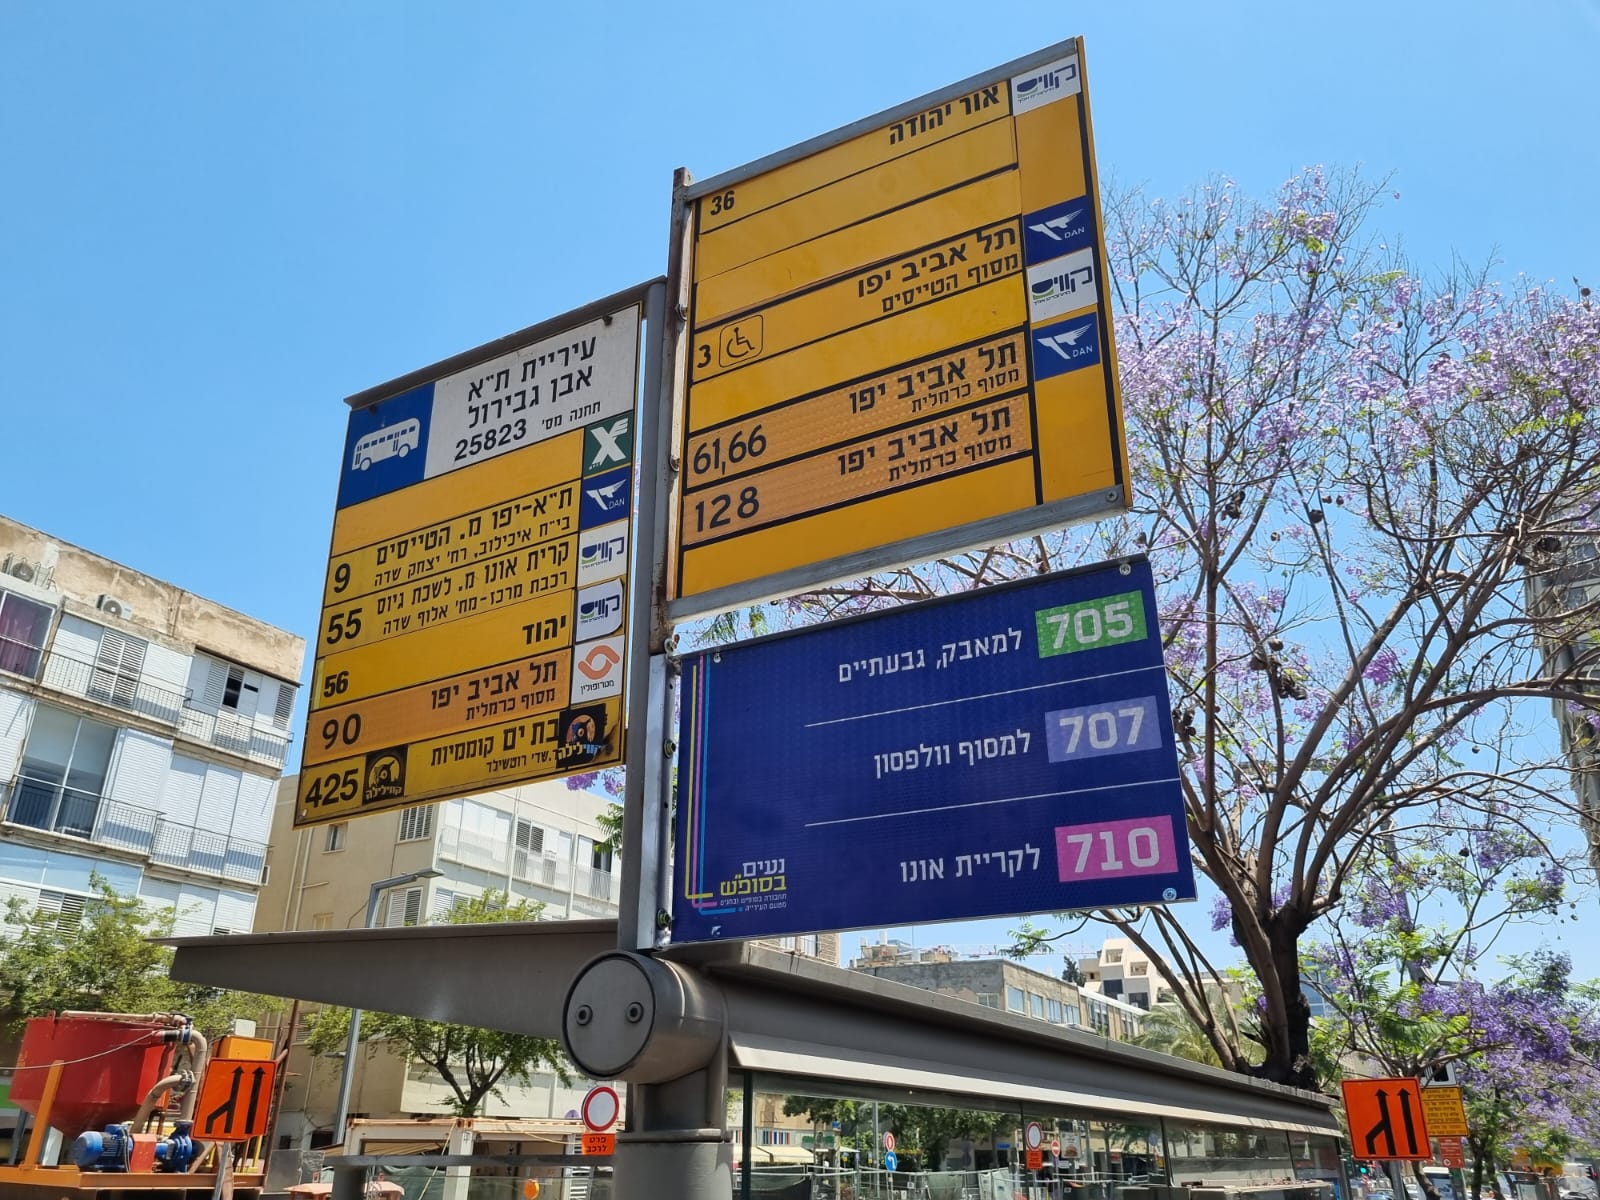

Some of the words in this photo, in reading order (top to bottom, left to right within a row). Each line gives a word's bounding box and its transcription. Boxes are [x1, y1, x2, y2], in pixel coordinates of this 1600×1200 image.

[959, 85, 1000, 115] אור
[889, 104, 951, 145] יהודה
[710, 190, 735, 216] 36
[976, 226, 1017, 256] תל
[1064, 226, 1085, 239] DAN
[901, 242, 967, 282] אביב
[968, 253, 1019, 286] מסוף
[858, 269, 891, 299] יפו
[882, 270, 959, 313] הטייסים
[521, 336, 597, 381] עיריית
[697, 344, 711, 369] 3
[979, 341, 1017, 372] תל
[1072, 344, 1093, 358] DAN
[468, 368, 510, 402] ת"א
[550, 365, 593, 403] אבן
[897, 356, 966, 401] אביב
[976, 368, 1020, 394] מסוף
[468, 385, 541, 429] גבירול
[569, 401, 601, 422] תחנה
[849, 382, 886, 414] יפו
[911, 382, 972, 413] כרמלית
[971, 405, 1011, 436] תל
[454, 418, 527, 462] 25823
[693, 424, 768, 476] 61,66
[887, 420, 958, 463] אביב
[963, 434, 1013, 463] מסוף
[837, 446, 875, 475] יפו
[889, 447, 957, 482] כרמלית
[608, 498, 625, 510] DAN
[695, 486, 760, 532] 128
[459, 516, 482, 540] מ.
[539, 515, 571, 538] בי"ח
[376, 526, 451, 566] הטייסים
[526, 541, 570, 572] קרית
[333, 563, 351, 594] 9
[374, 566, 402, 587] שדה
[407, 555, 441, 577] יצחק
[484, 556, 519, 585] אונו
[411, 576, 452, 606] לשכת
[529, 571, 568, 594] רכבת
[376, 592, 405, 616] גיוס
[417, 604, 449, 627] אלוף
[326, 607, 363, 645] 55
[383, 614, 411, 635] שדה
[521, 614, 567, 646] יהוד
[1046, 600, 1134, 650] 705
[838, 648, 926, 683] גבעתיים
[936, 628, 1023, 673] למאבק,
[323, 670, 350, 698] 56
[467, 670, 521, 701] אביב
[529, 660, 558, 685] תל
[580, 680, 615, 695] מטרופולין
[431, 684, 460, 710] יפו
[466, 697, 516, 721] כרמלית
[521, 688, 556, 709] מסוף
[322, 713, 361, 750] 90
[503, 724, 526, 752] ים
[530, 717, 559, 746] בת
[1058, 705, 1146, 756] 707
[430, 735, 495, 767] קוממיות
[874, 744, 951, 780] וולפסון
[957, 729, 1032, 767] למסוף
[486, 754, 528, 774] רוטשילד
[305, 767, 359, 809] 425
[955, 843, 1041, 877] לקריית
[1066, 825, 1160, 874] 710
[742, 858, 785, 878] נעים
[900, 856, 945, 884] אונו
